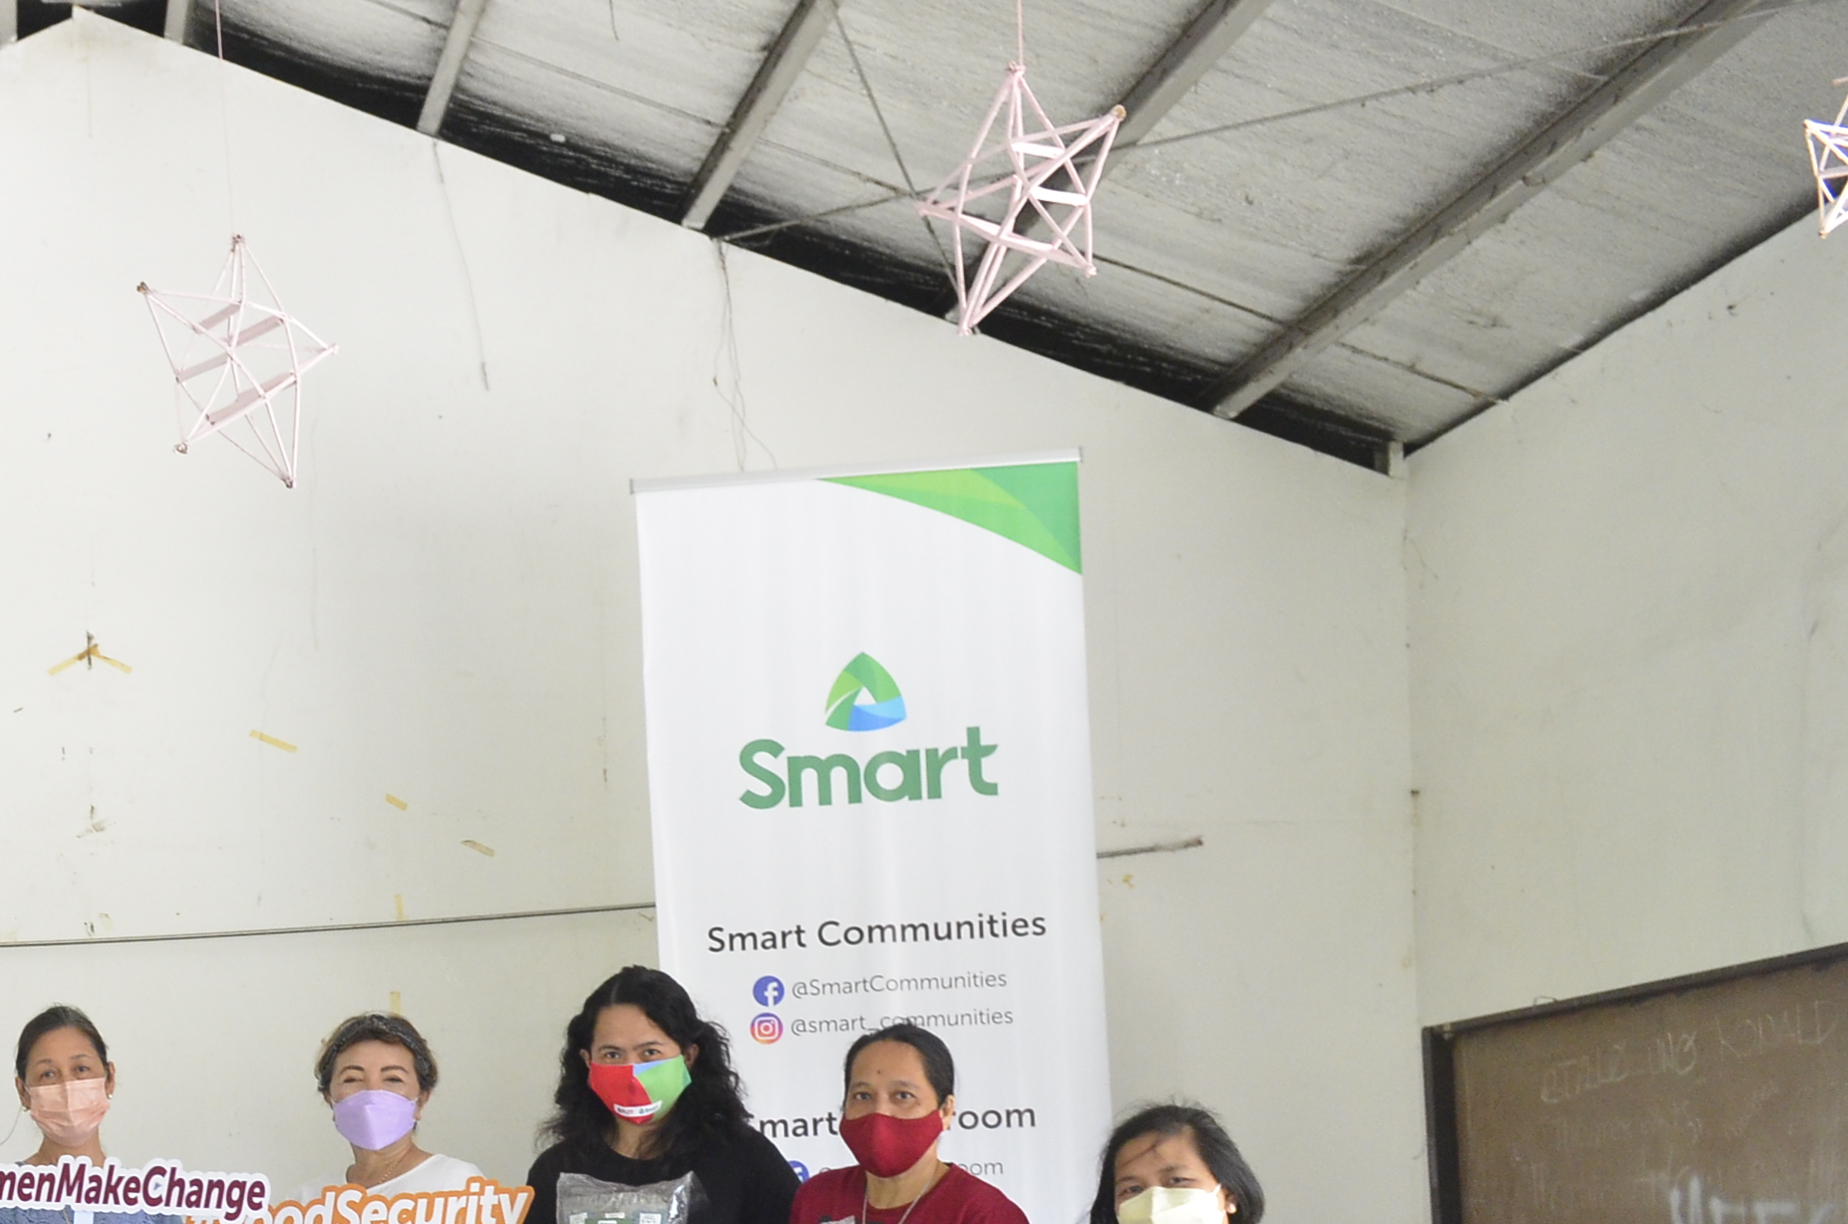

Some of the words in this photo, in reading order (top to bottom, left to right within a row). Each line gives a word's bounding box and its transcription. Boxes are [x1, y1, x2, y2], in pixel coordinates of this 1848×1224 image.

[738, 726, 1000, 811] Smart
[707, 923, 807, 953] Smart
[817, 911, 1047, 949] Communities
[791, 971, 1008, 999] @SmartCommunities
[745, 1111, 839, 1138] mart
